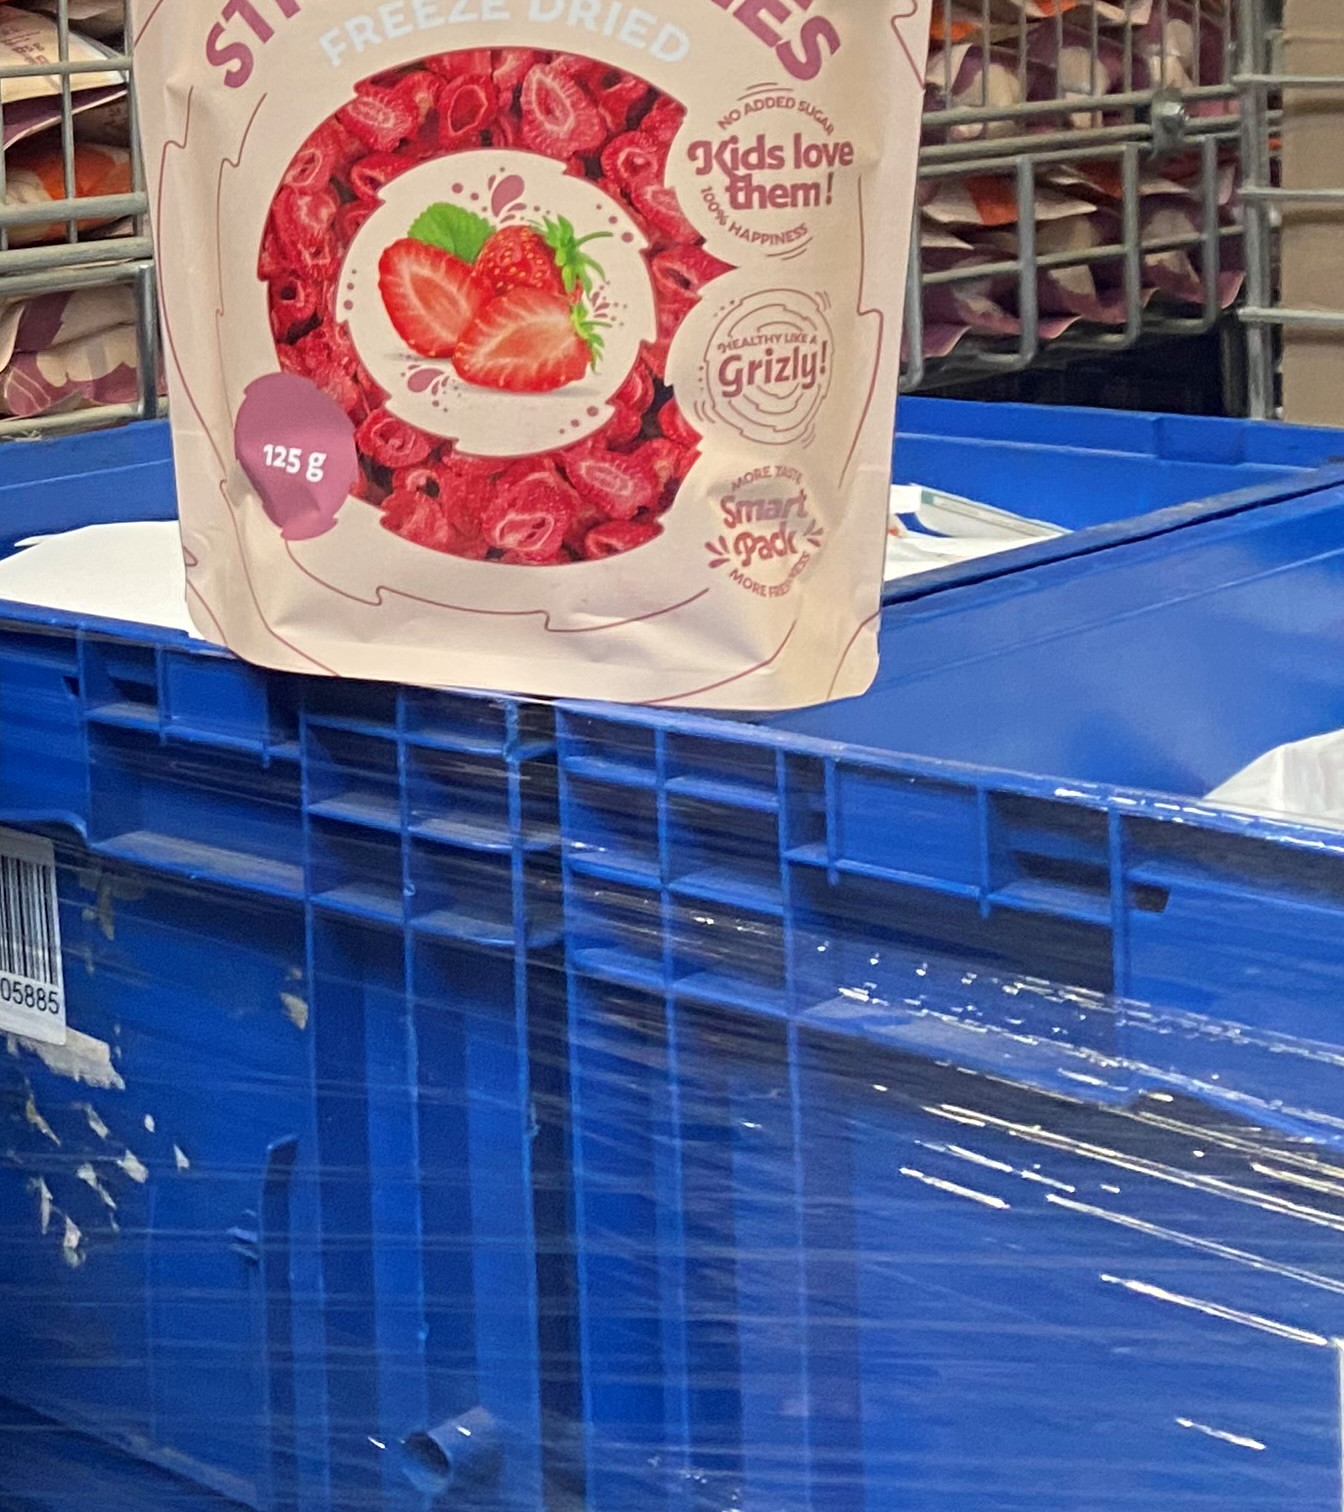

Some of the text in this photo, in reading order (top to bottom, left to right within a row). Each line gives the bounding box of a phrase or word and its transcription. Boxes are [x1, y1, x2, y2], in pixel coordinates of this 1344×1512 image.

[717, 95, 835, 136] NO ADDED SUGAR
[687, 132, 855, 178] Kids love
[724, 172, 835, 210] them!
[701, 186, 809, 246] 100% HAPPINESS
[717, 332, 818, 354] HEALTHY LIKE A
[718, 340, 828, 398] Grizly!
[263, 444, 327, 483] 125 g
[731, 466, 773, 491] MORE
[720, 489, 809, 529] Smart
[733, 521, 798, 567] Pack
[729, 569, 768, 598] MORE
